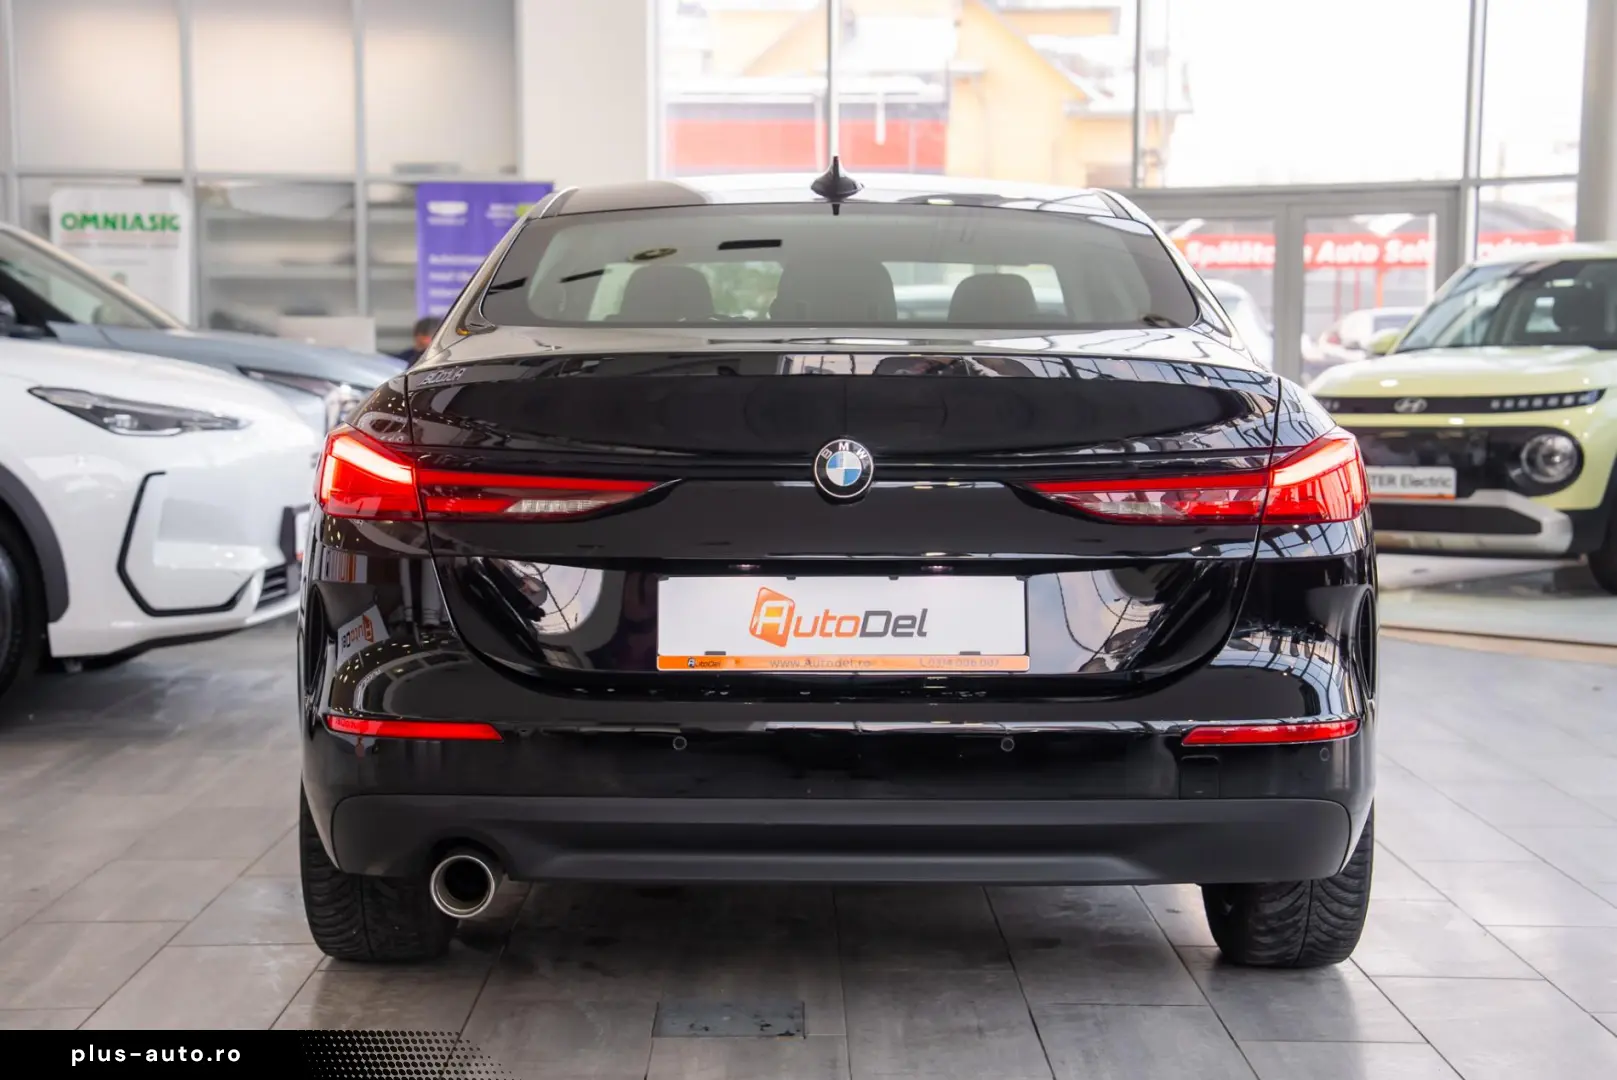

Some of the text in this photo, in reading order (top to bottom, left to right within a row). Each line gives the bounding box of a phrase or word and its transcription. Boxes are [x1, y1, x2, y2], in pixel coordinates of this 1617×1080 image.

[820, 441, 868, 460] BMW
[1370, 473, 1397, 487] TER
[752, 592, 928, 643] AutoDel
